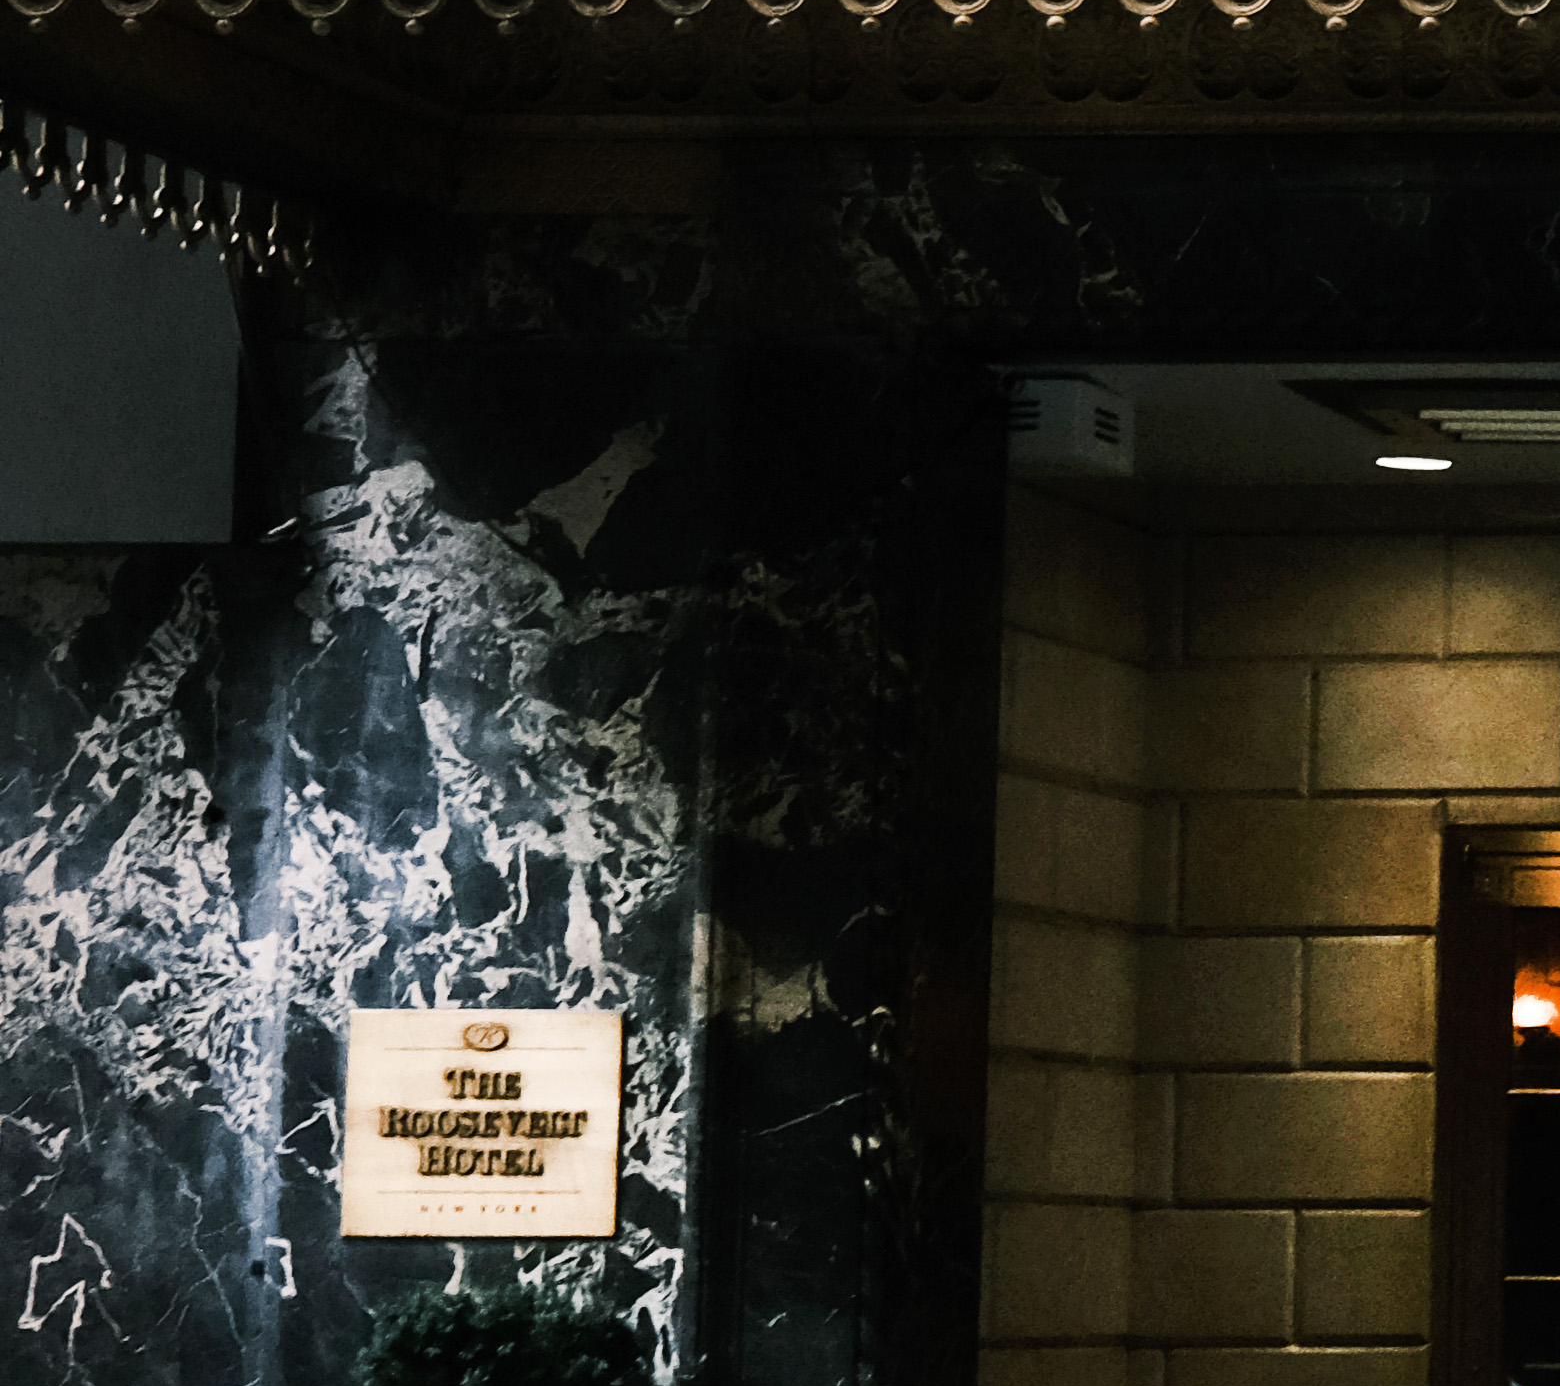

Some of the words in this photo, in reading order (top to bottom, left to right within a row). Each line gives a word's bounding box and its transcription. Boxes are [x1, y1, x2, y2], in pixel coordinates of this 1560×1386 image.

[444, 1069, 522, 1100] THE
[378, 1106, 588, 1139] ROOSEVELT
[417, 1144, 545, 1176] HOTEL
